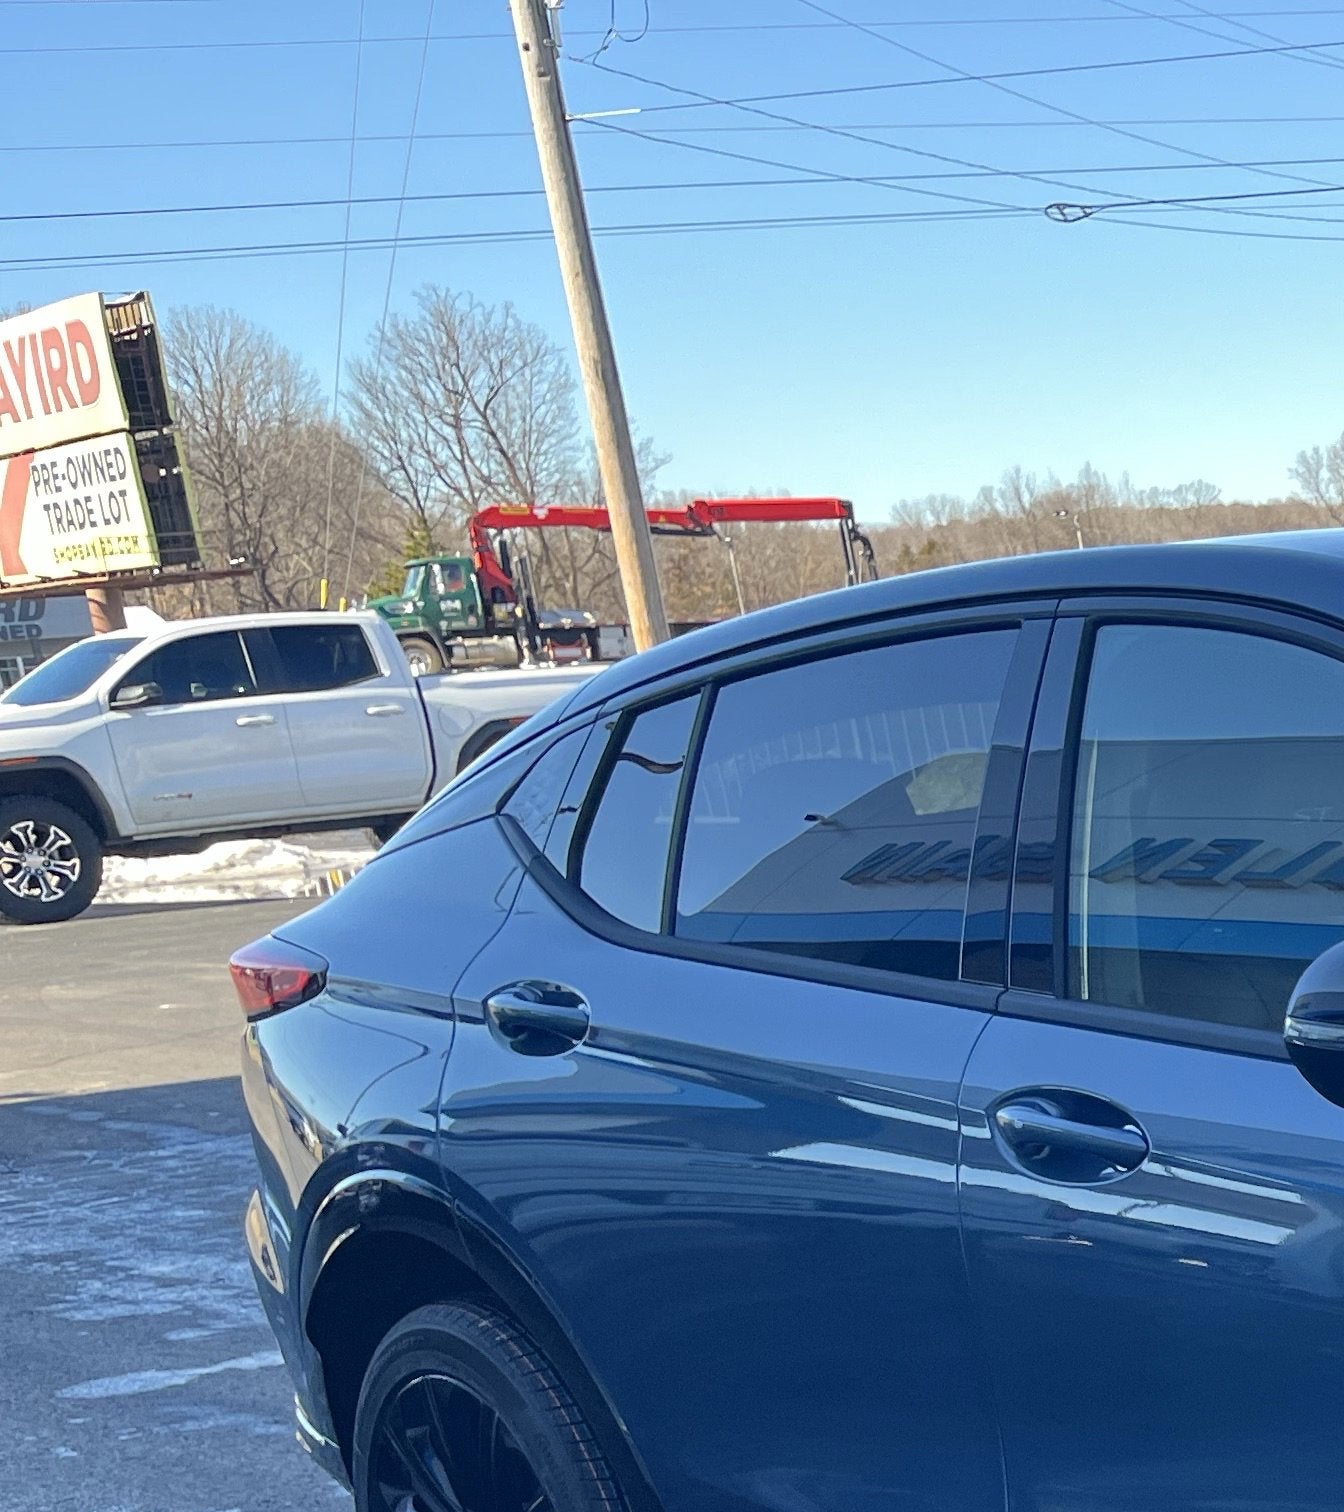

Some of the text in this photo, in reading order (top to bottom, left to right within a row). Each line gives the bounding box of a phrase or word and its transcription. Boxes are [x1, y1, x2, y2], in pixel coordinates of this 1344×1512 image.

[31, 447, 127, 497] PRE-OWNED
[43, 489, 130, 535] TRADE LOT
